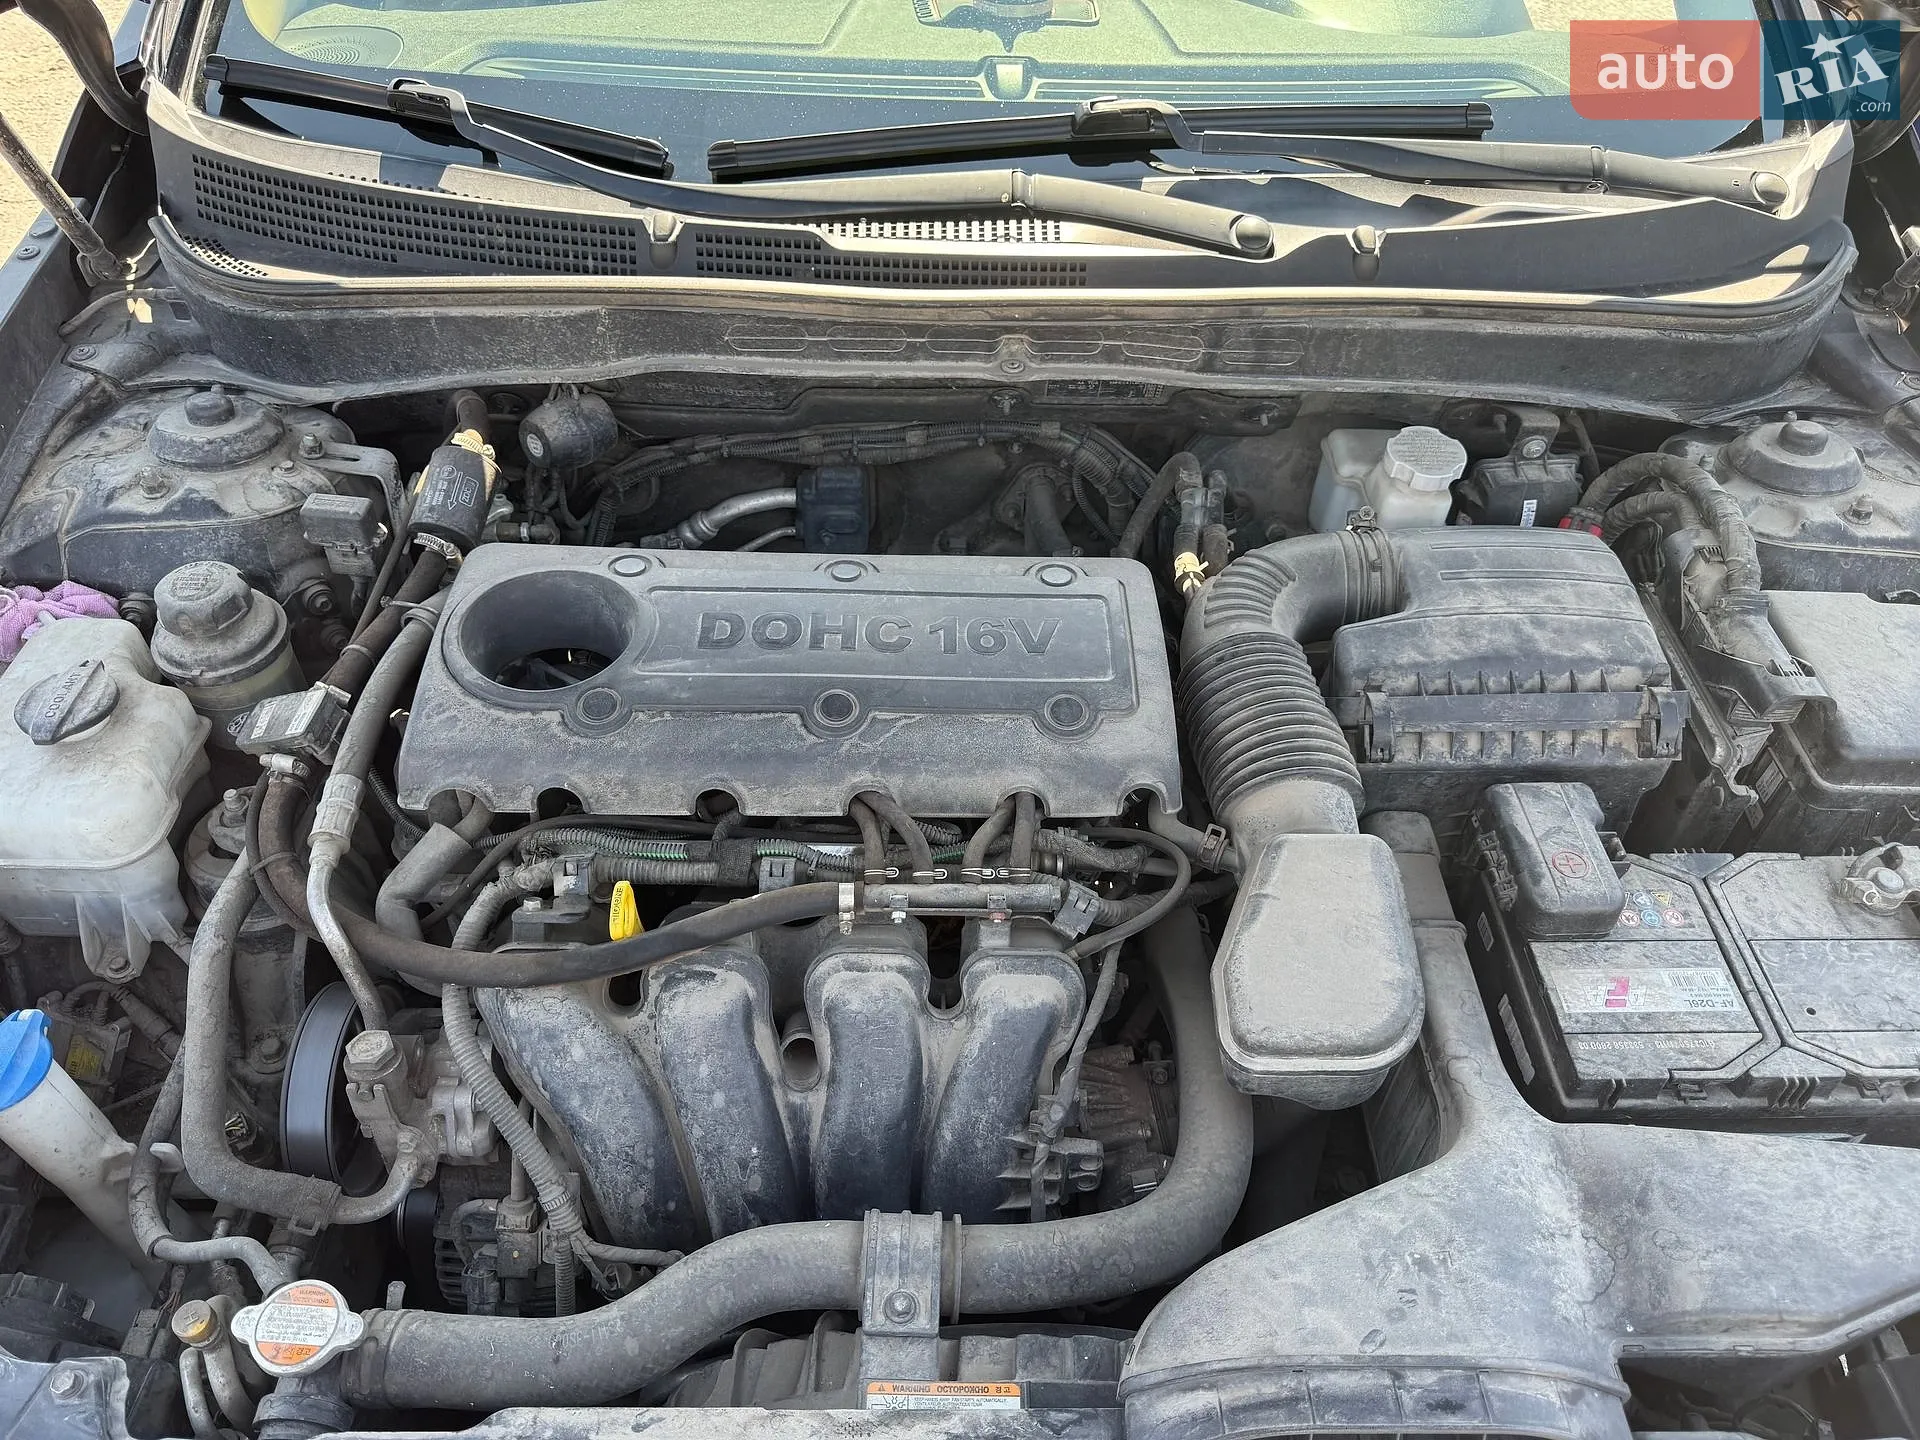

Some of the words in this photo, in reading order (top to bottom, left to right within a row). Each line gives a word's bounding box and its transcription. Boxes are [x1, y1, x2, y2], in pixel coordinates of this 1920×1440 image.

[696, 611, 914, 655] DOHC
[928, 616, 1063, 657] 16V
[44, 671, 81, 718] COOLANT
[892, 1384, 931, 1393] WARNING
